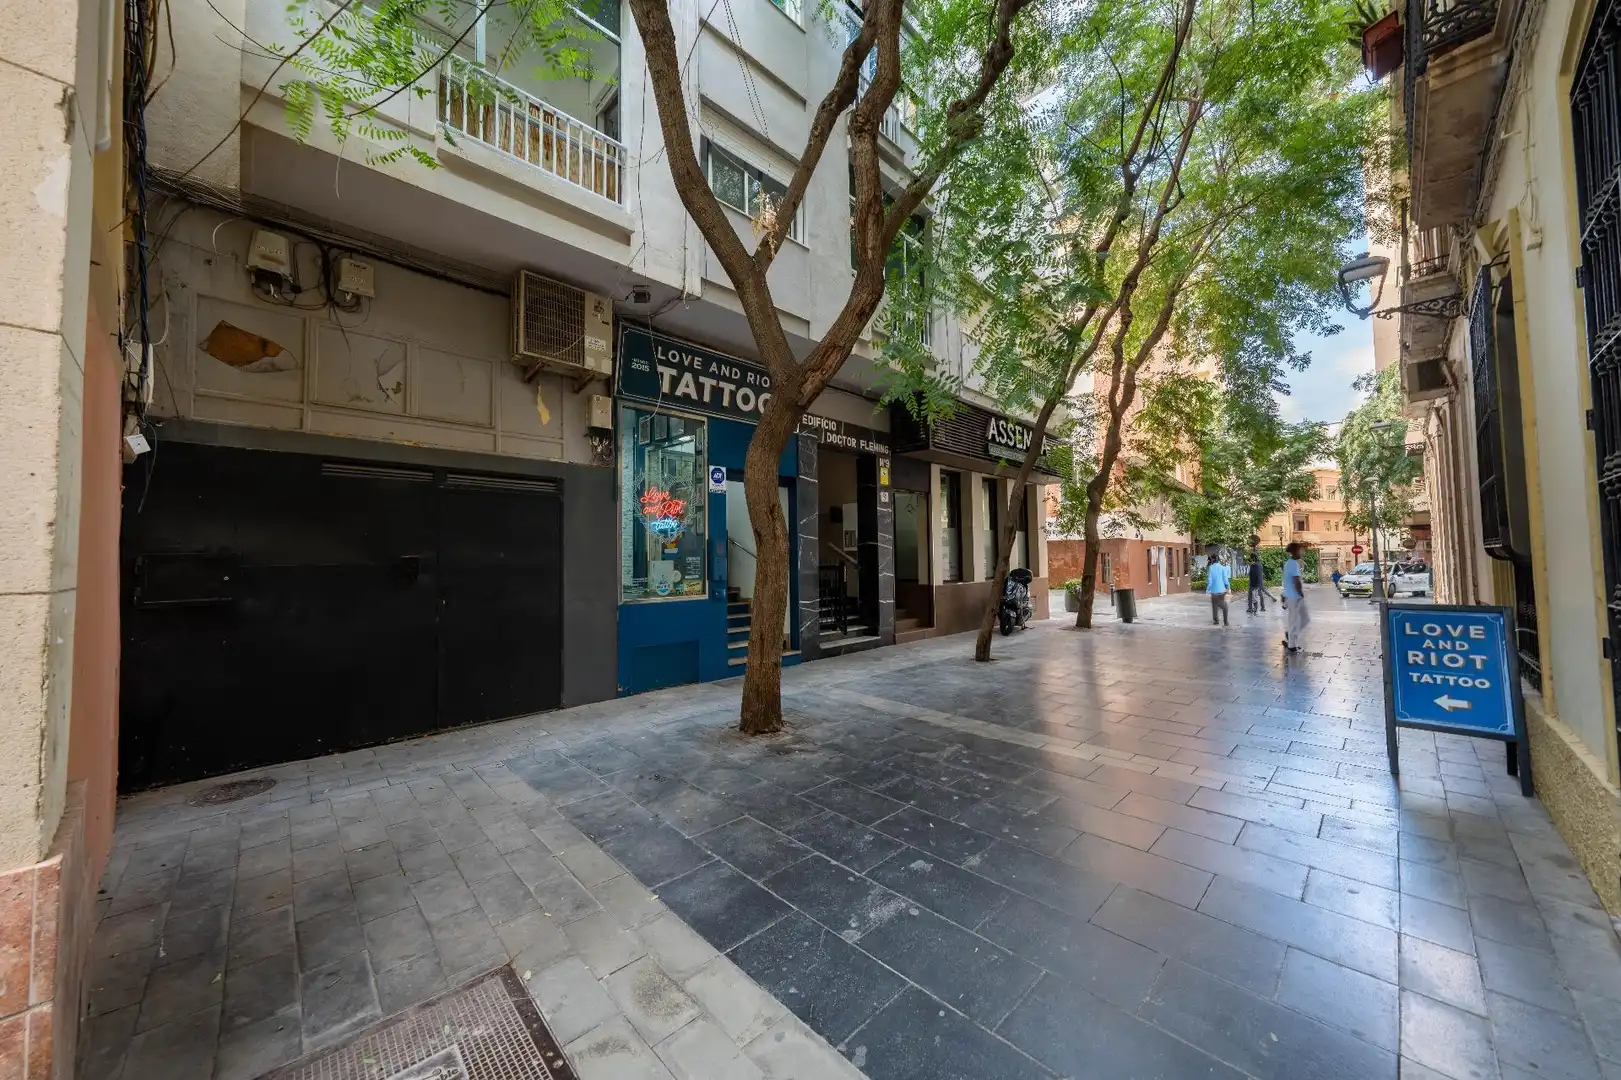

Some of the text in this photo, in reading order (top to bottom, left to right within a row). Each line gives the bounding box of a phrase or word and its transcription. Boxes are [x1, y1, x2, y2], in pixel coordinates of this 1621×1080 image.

[631, 362, 650, 373] 2015
[657, 346, 770, 388] LOVE AND RIO
[802, 414, 837, 431] EDIFICIO
[826, 432, 889, 455] DOCTOR FLEMING
[988, 417, 1049, 456] ASSEMA
[1404, 622, 1486, 639] LOVE
[1422, 639, 1470, 651] AND
[1407, 650, 1488, 670] RIOT
[1409, 672, 1491, 689] TATTOO
